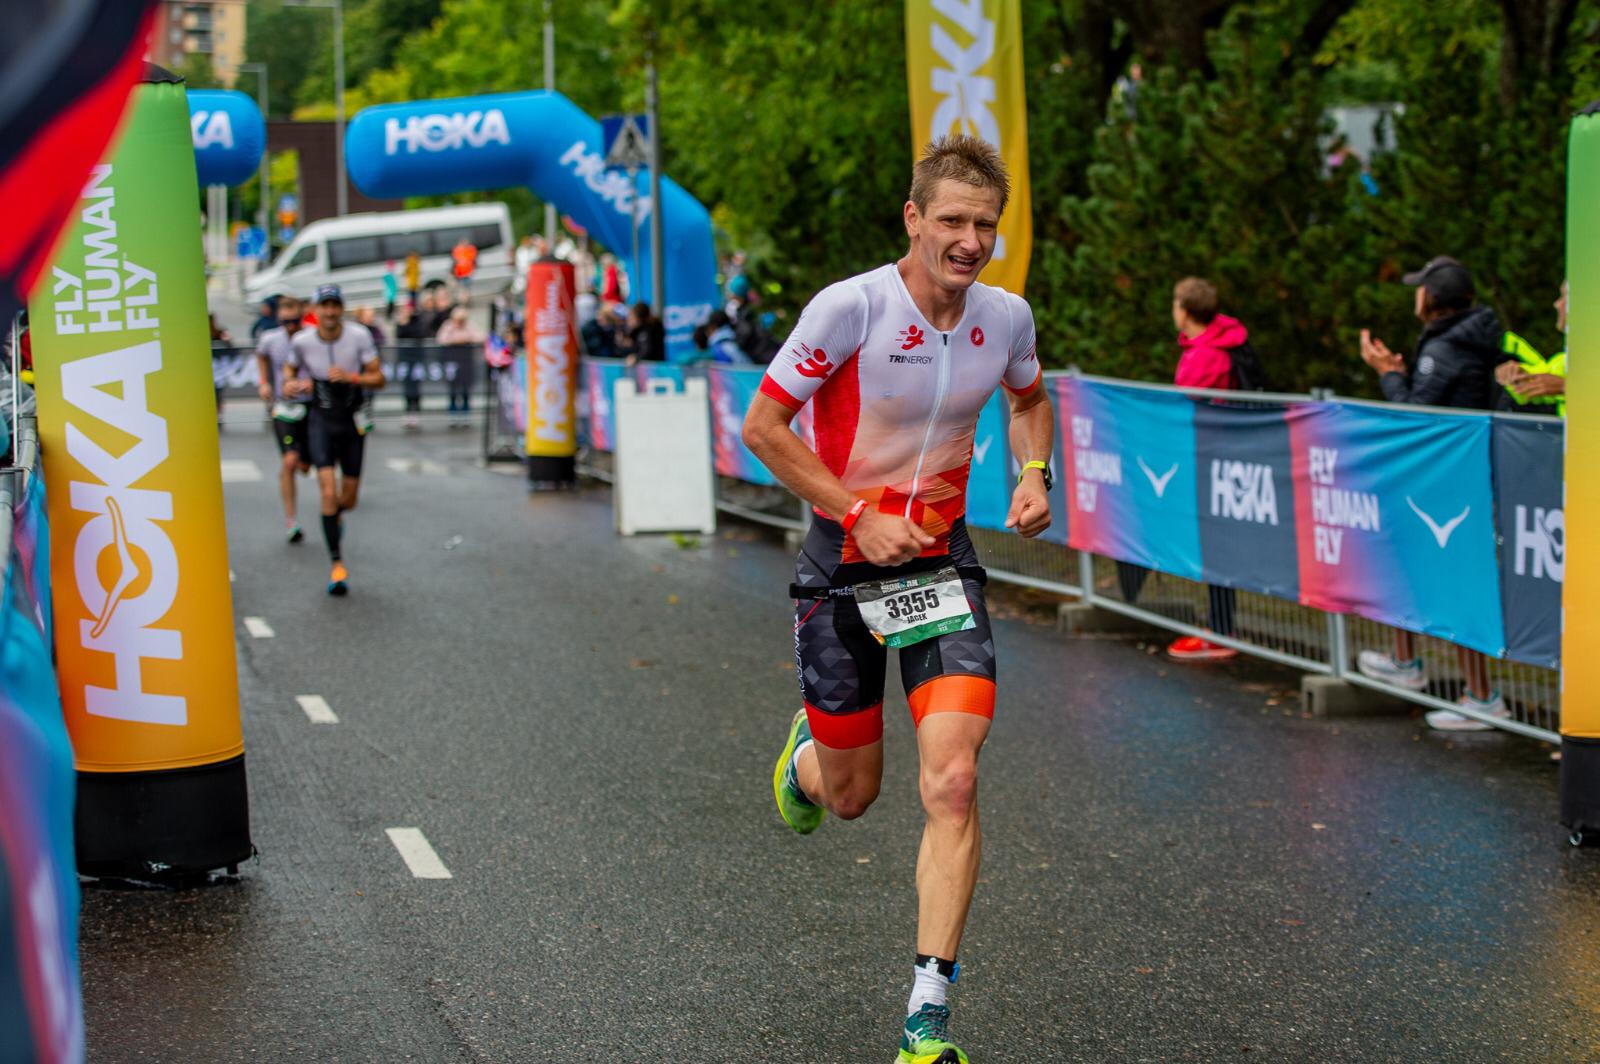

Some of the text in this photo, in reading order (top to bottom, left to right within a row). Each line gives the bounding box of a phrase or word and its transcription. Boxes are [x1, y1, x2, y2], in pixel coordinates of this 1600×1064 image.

[385, 109, 510, 155] HOKA
[81, 163, 123, 334] HUMAN
[52, 266, 85, 335] FLY
[123, 260, 161, 330] FLY
[889, 354, 935, 365] TRINERGY
[535, 335, 569, 443] HOKA
[1071, 414, 1094, 449] FLY
[1074, 447, 1123, 487] HUMAN
[1309, 445, 1338, 485] FLY
[1076, 481, 1099, 514] FLY
[1210, 458, 1280, 527] HOKA
[1311, 492, 1381, 533] HUMAN
[60, 341, 189, 727] HOKA
[1314, 526, 1342, 566] FLY
[885, 588, 941, 619] 3355
[906, 612, 929, 626] JACEK
